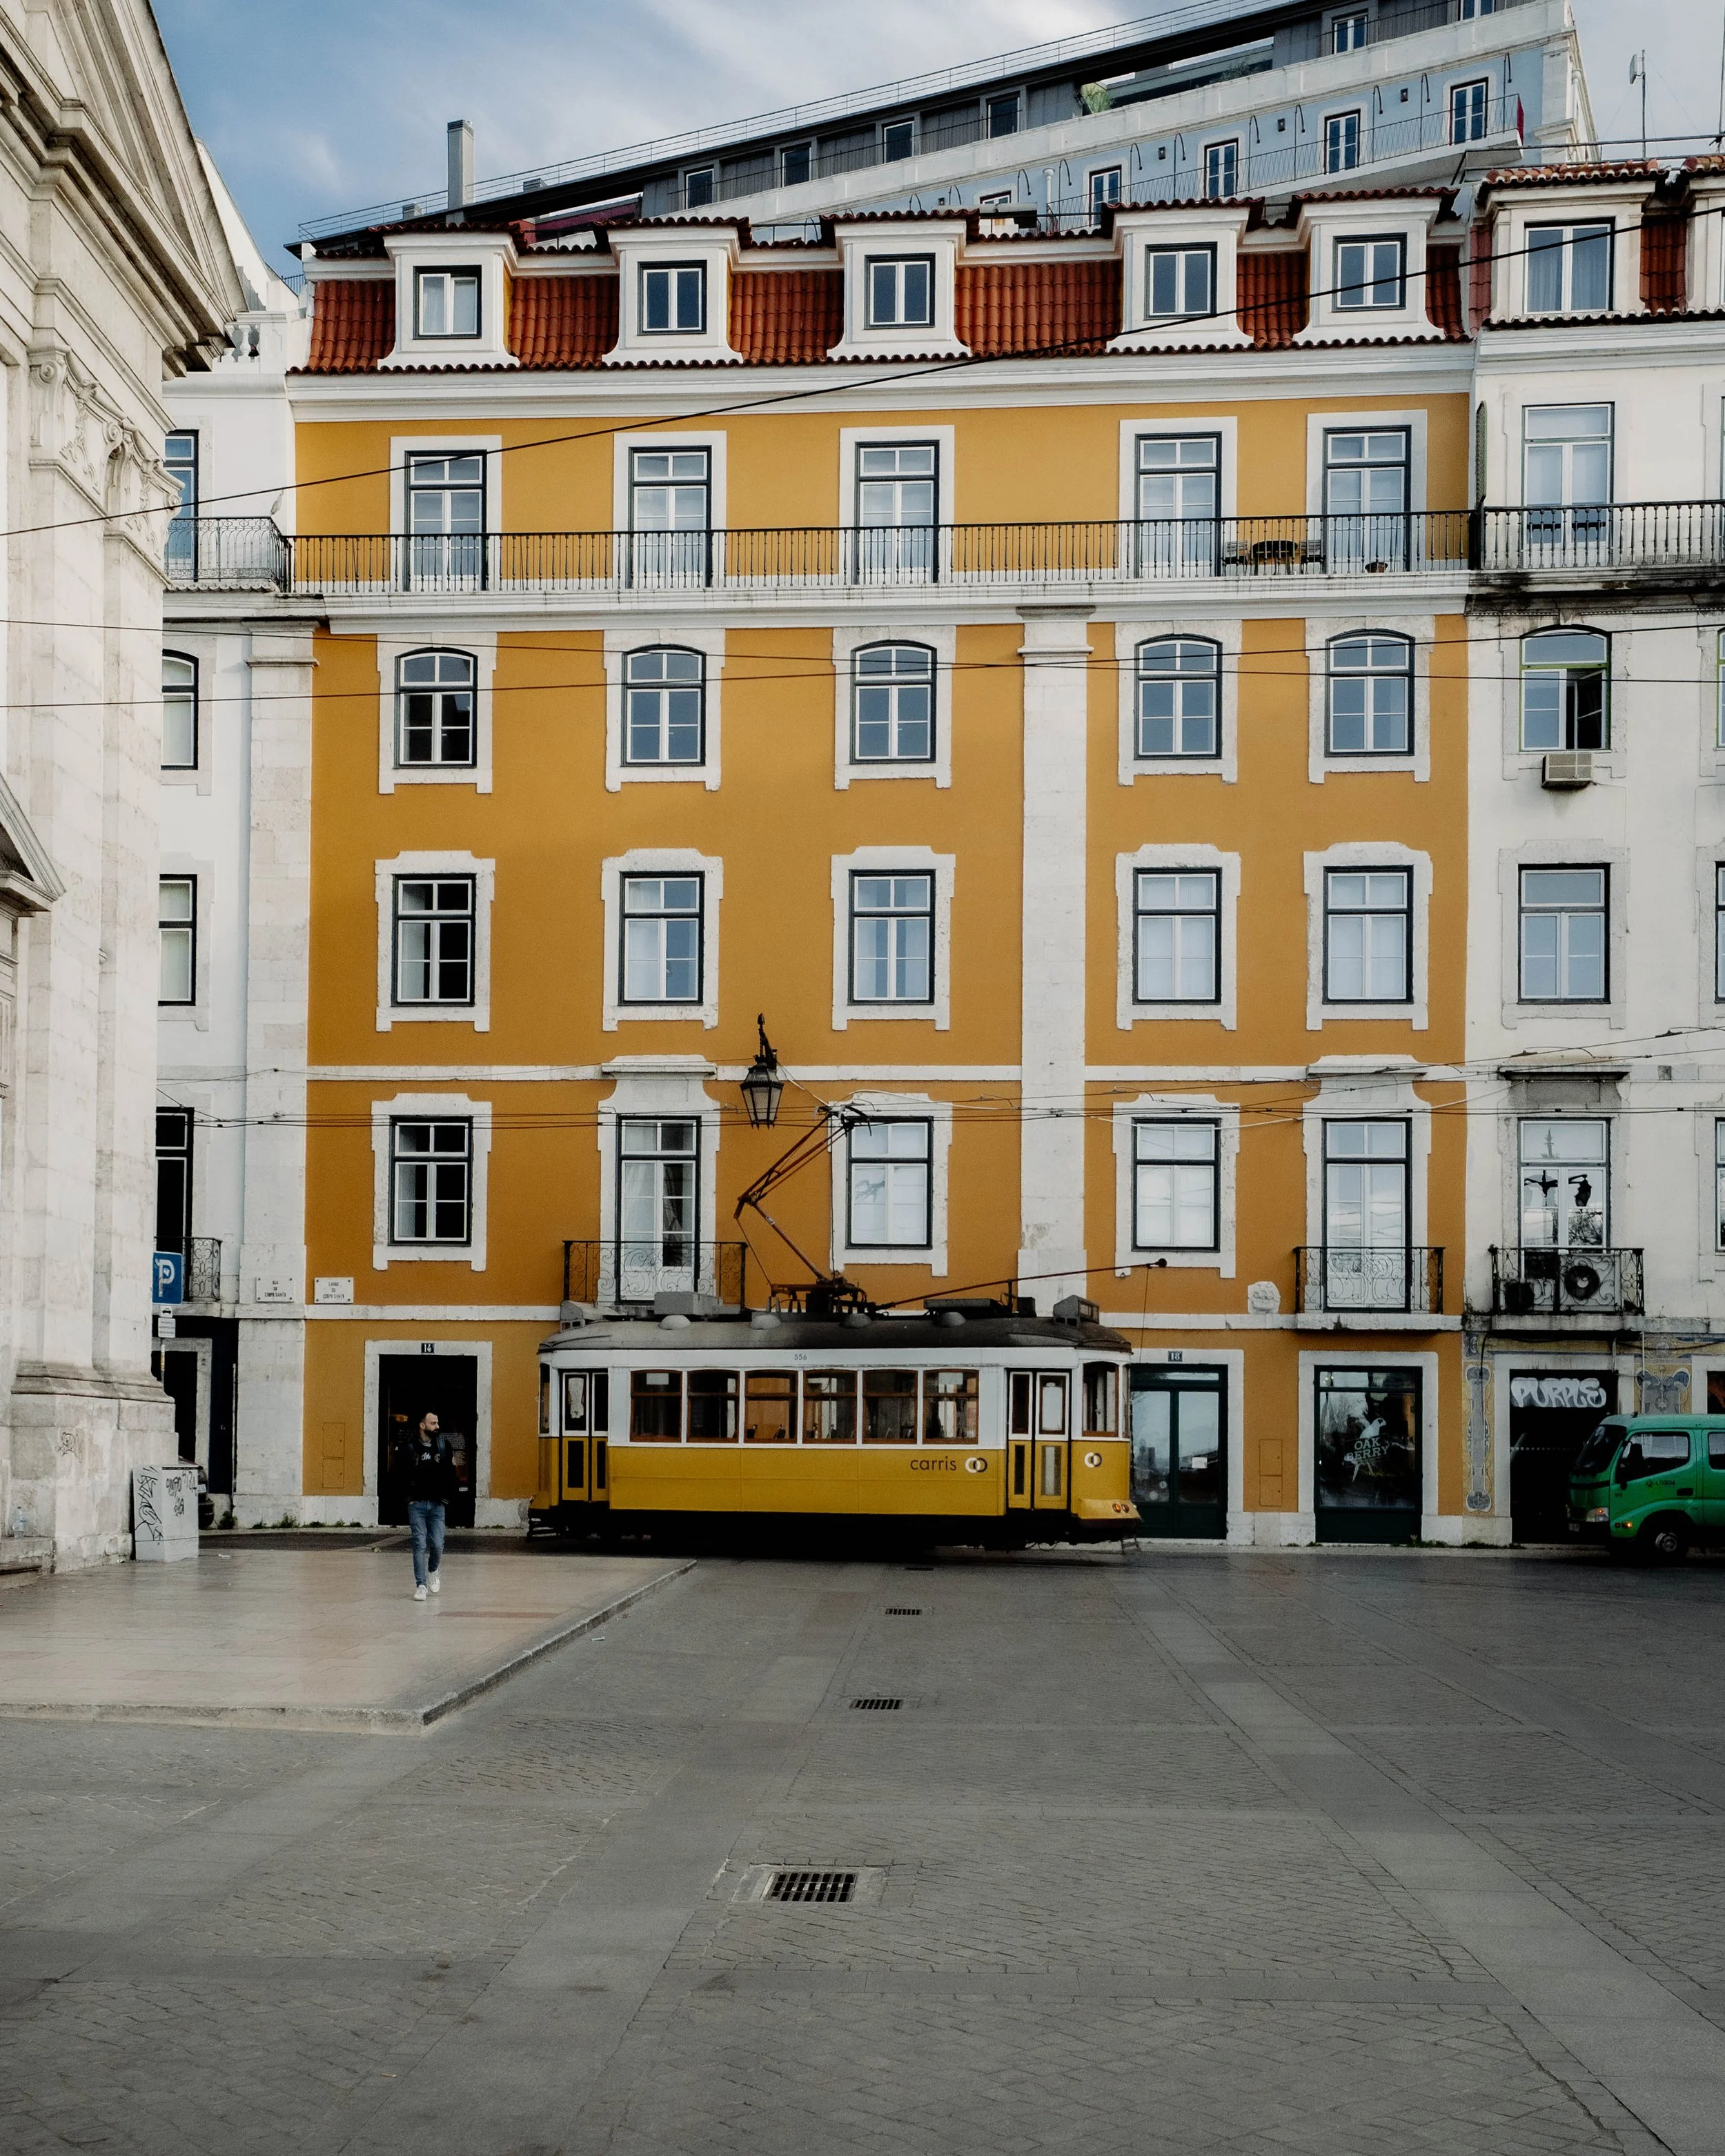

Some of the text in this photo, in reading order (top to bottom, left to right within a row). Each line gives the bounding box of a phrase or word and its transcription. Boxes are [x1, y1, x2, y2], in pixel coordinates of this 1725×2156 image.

[1171, 1352, 1180, 1361] 18
[1510, 1377, 1606, 1407] PURPLE
[1354, 1437, 1381, 1450] OAK
[1345, 1445, 1390, 1462] BERRY
[910, 1456, 957, 1471] carris
